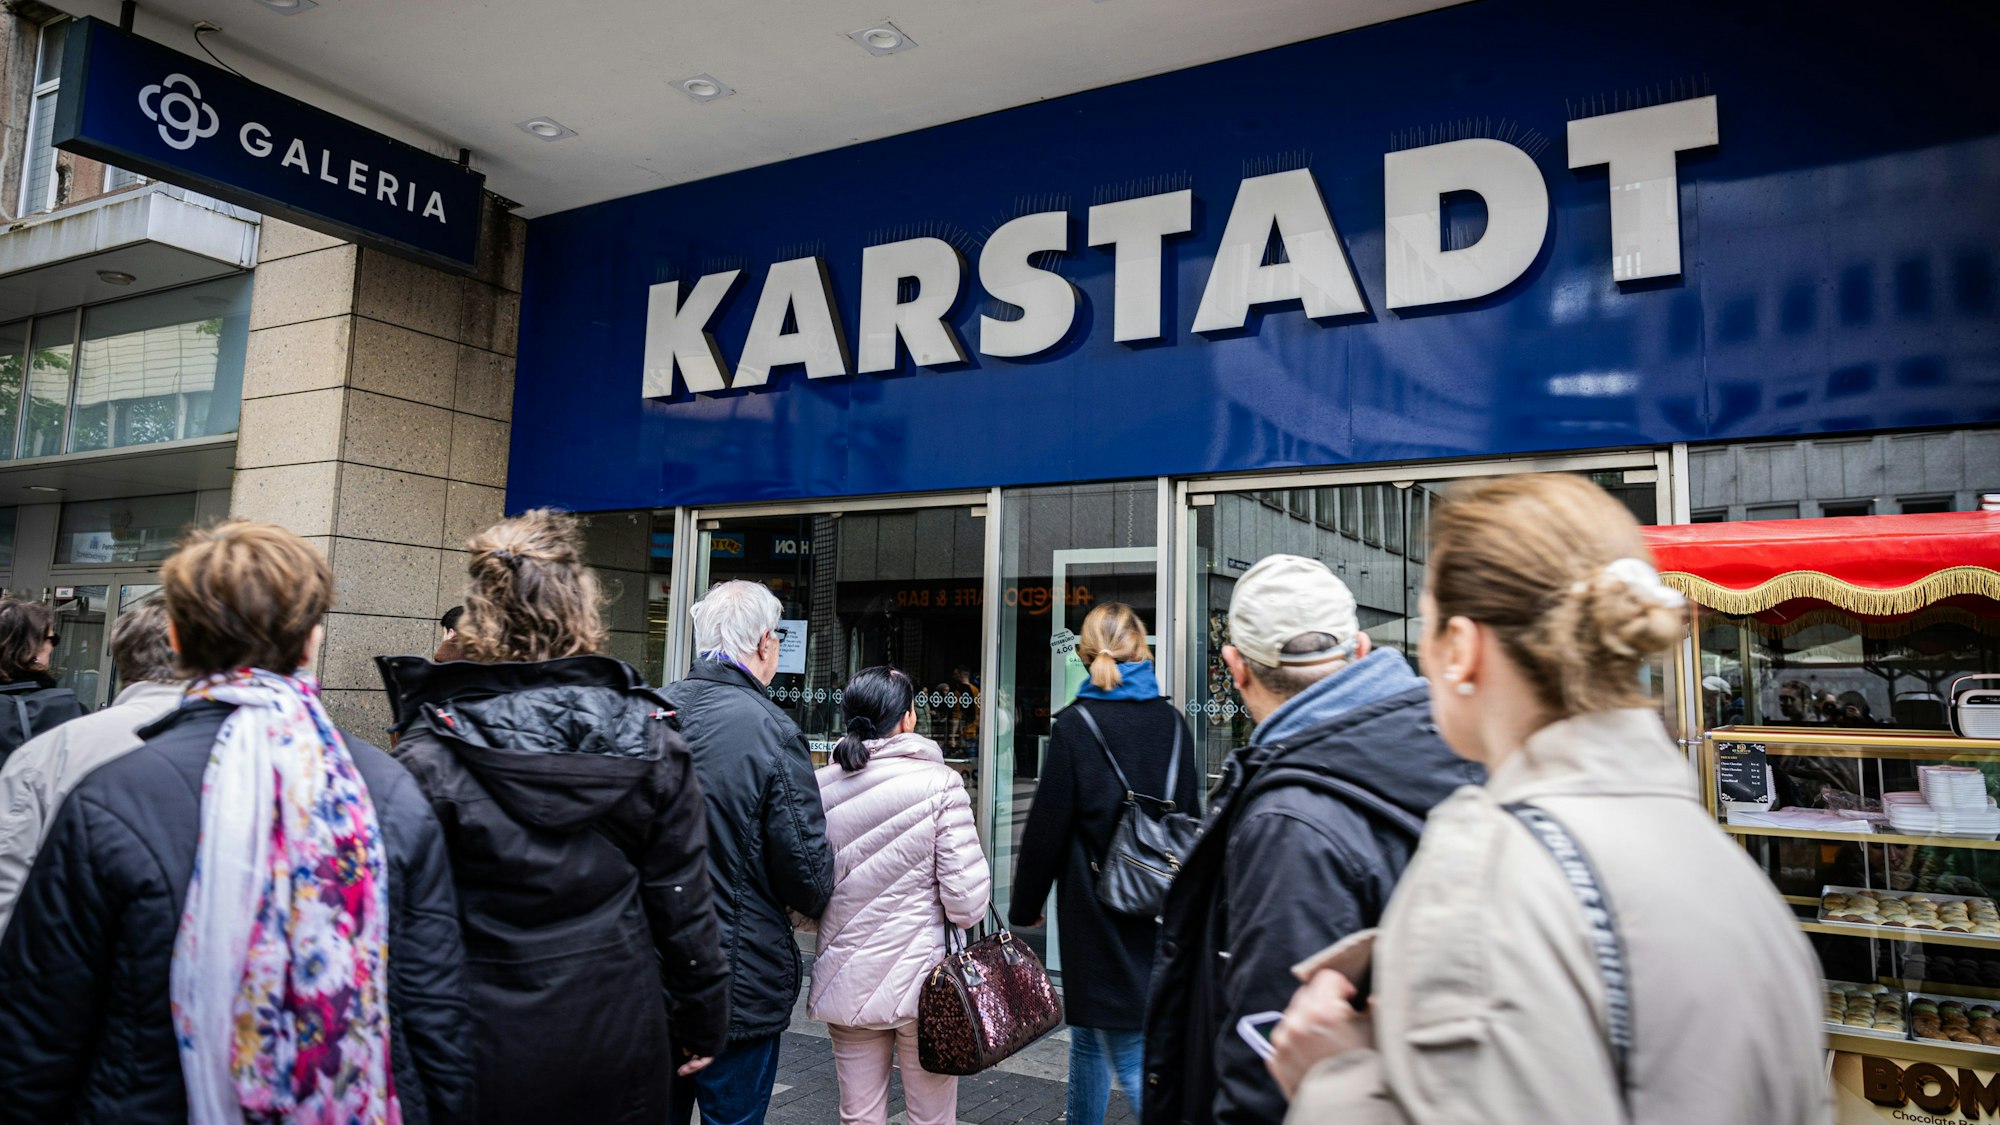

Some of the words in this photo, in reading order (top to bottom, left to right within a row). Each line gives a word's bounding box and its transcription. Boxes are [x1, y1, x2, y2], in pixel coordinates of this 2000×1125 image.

[239, 121, 447, 224] GALERIA
[641, 94, 1719, 400] KARSTADT
[1892, 1110, 1955, 1125] Chocolate
